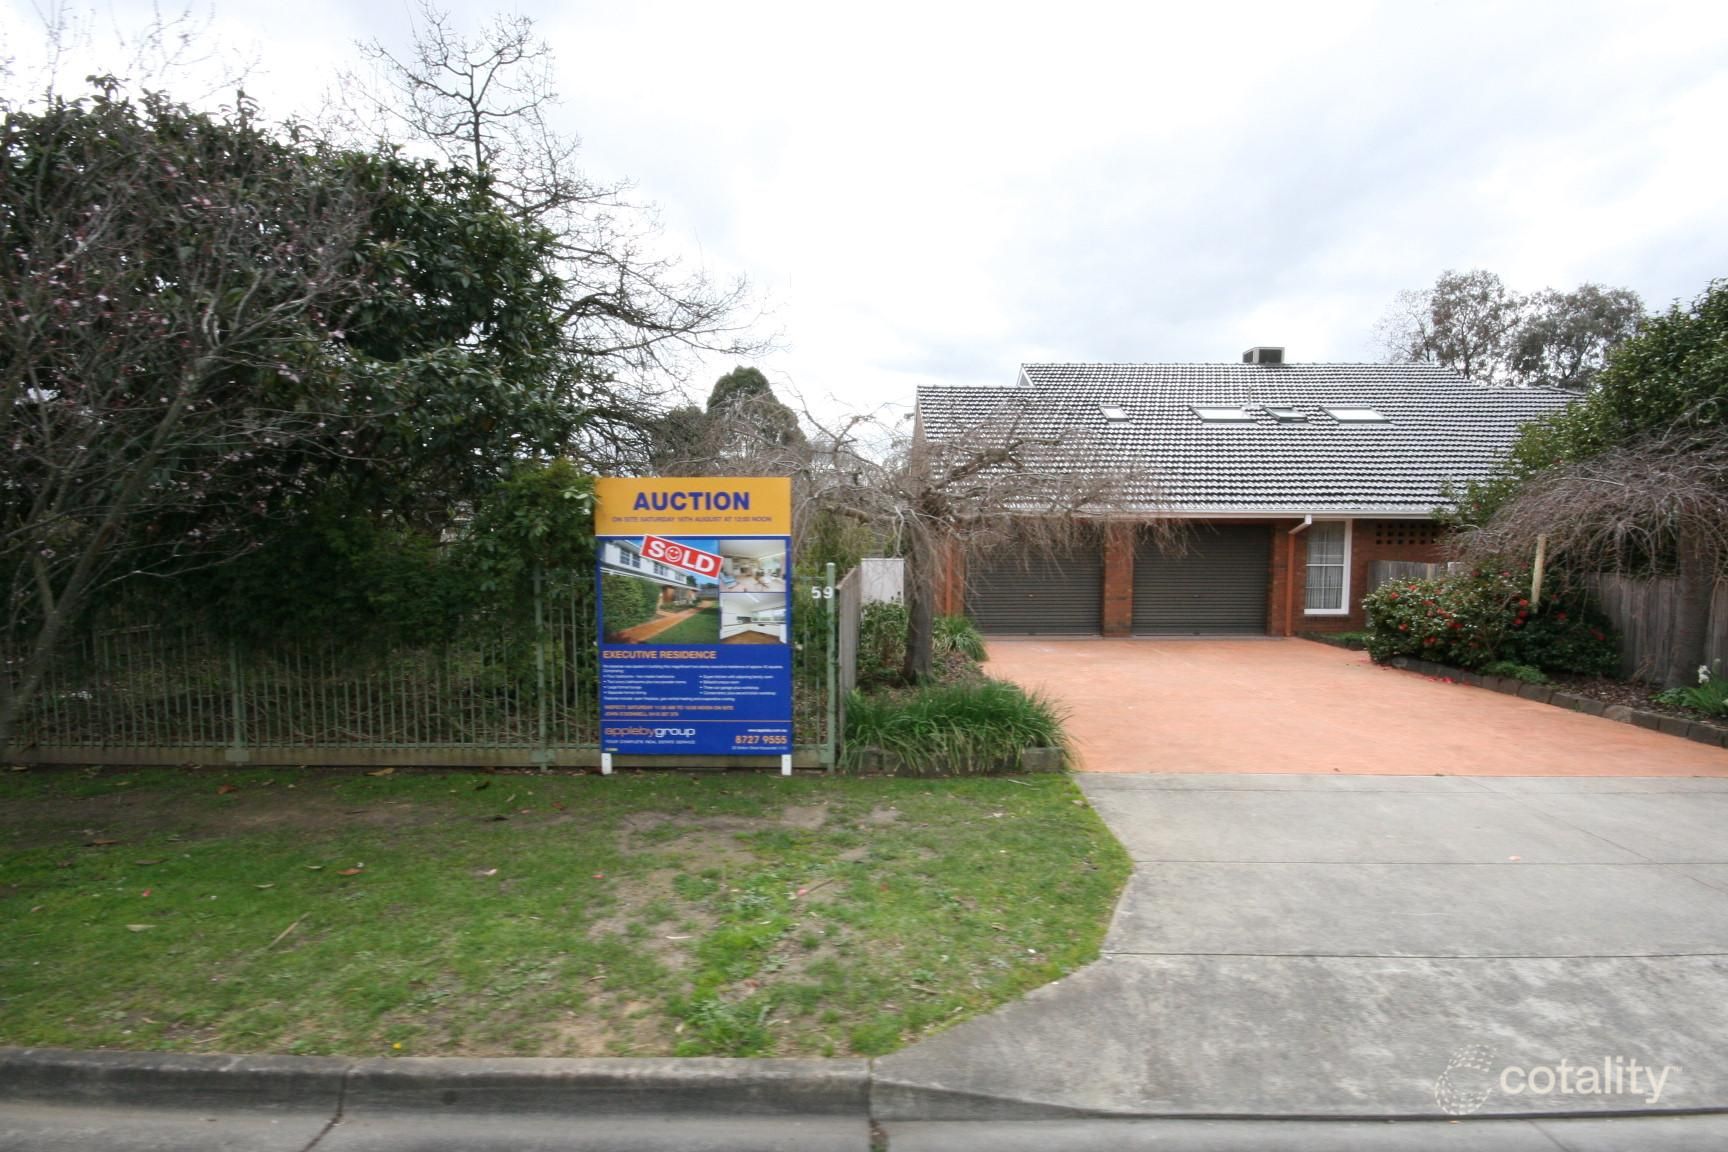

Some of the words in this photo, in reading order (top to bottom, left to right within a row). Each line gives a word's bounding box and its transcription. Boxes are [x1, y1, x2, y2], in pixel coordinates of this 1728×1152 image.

[633, 491, 750, 511] AUCTION
[648, 540, 715, 573] SOLD
[811, 585, 834, 599] 59
[602, 650, 657, 659] EXECUTIVE
[659, 650, 718, 660] RESIDENCE
[735, 735, 760, 744] 8727
[762, 735, 787, 745] 9555
